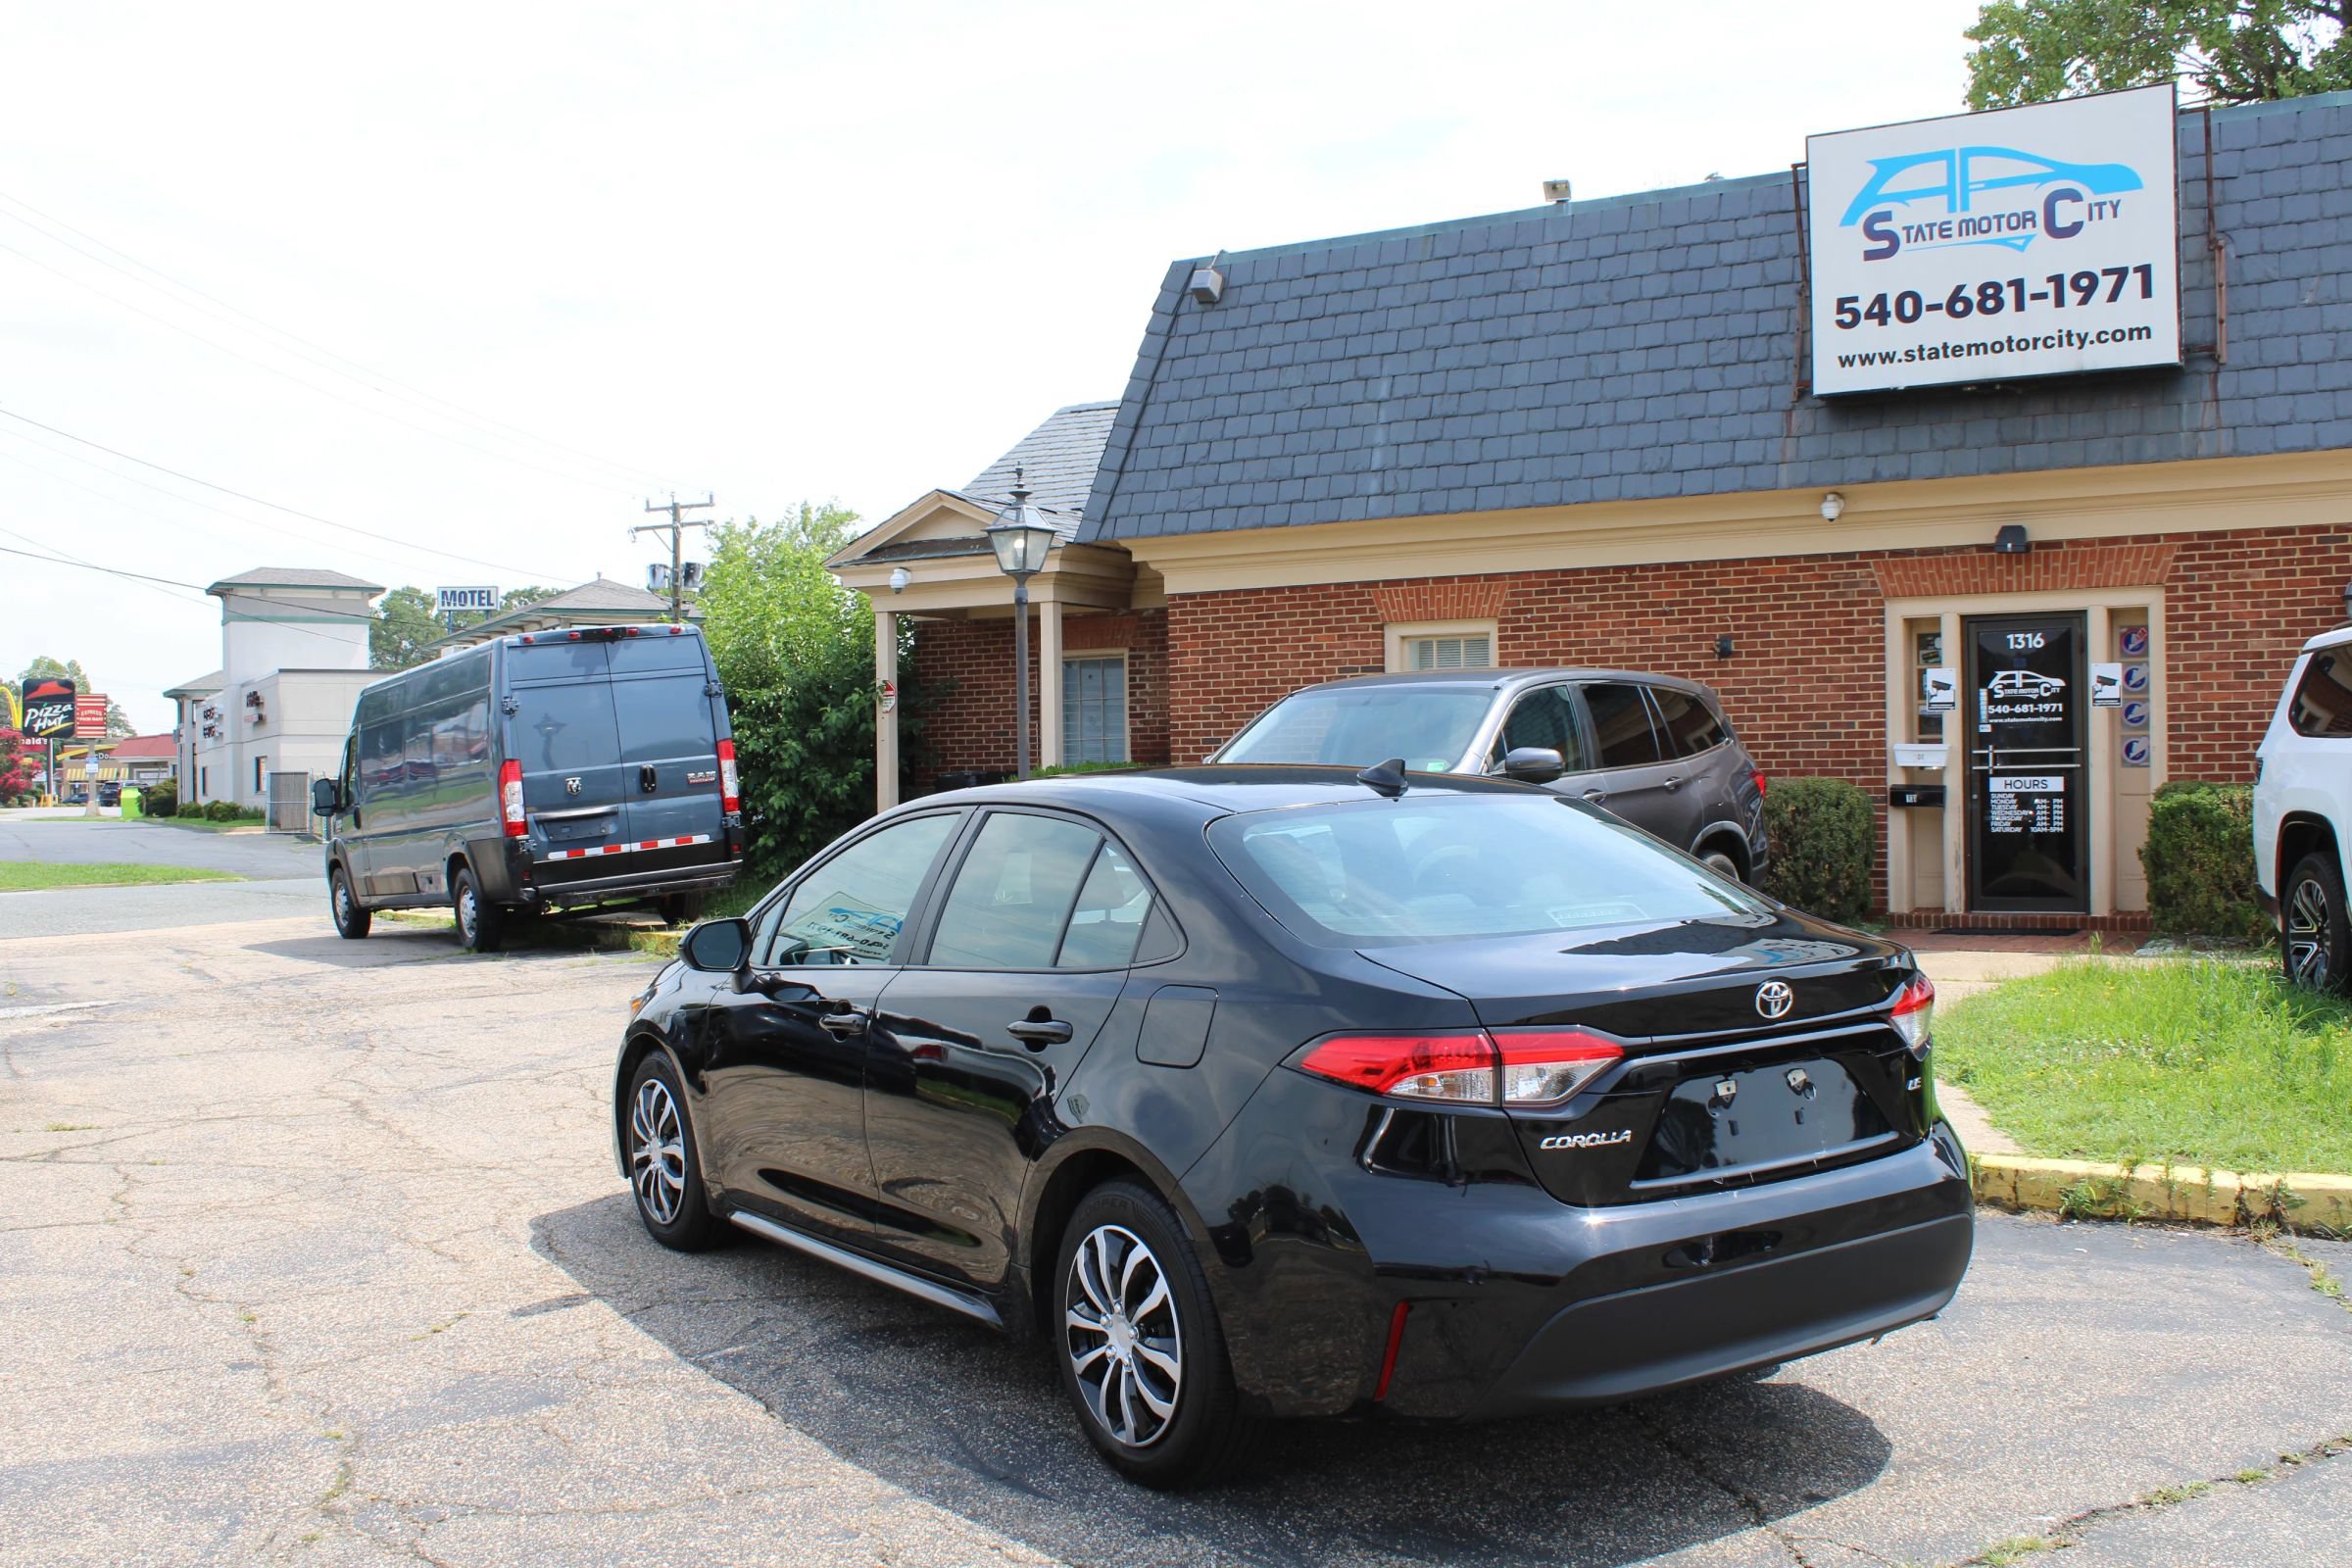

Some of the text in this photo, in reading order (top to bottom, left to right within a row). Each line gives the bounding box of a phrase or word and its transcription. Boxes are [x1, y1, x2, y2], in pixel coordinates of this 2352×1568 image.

[1863, 187, 2122, 262] STATE MOTOR CITY
[1835, 263, 2153, 330] 540-681-1971
[1838, 324, 2152, 368] www.statemotorcity.com
[441, 590, 495, 607] MOTEL
[2006, 632, 2045, 649] 1316
[24, 702, 74, 728] Pizza
[1987, 703, 2063, 713] 540-681-1971
[32, 713, 70, 733] Hut
[2004, 779, 2048, 790] HOURS
[1907, 1076, 1922, 1091] LE
[1540, 1129, 1632, 1150] COROLLA
